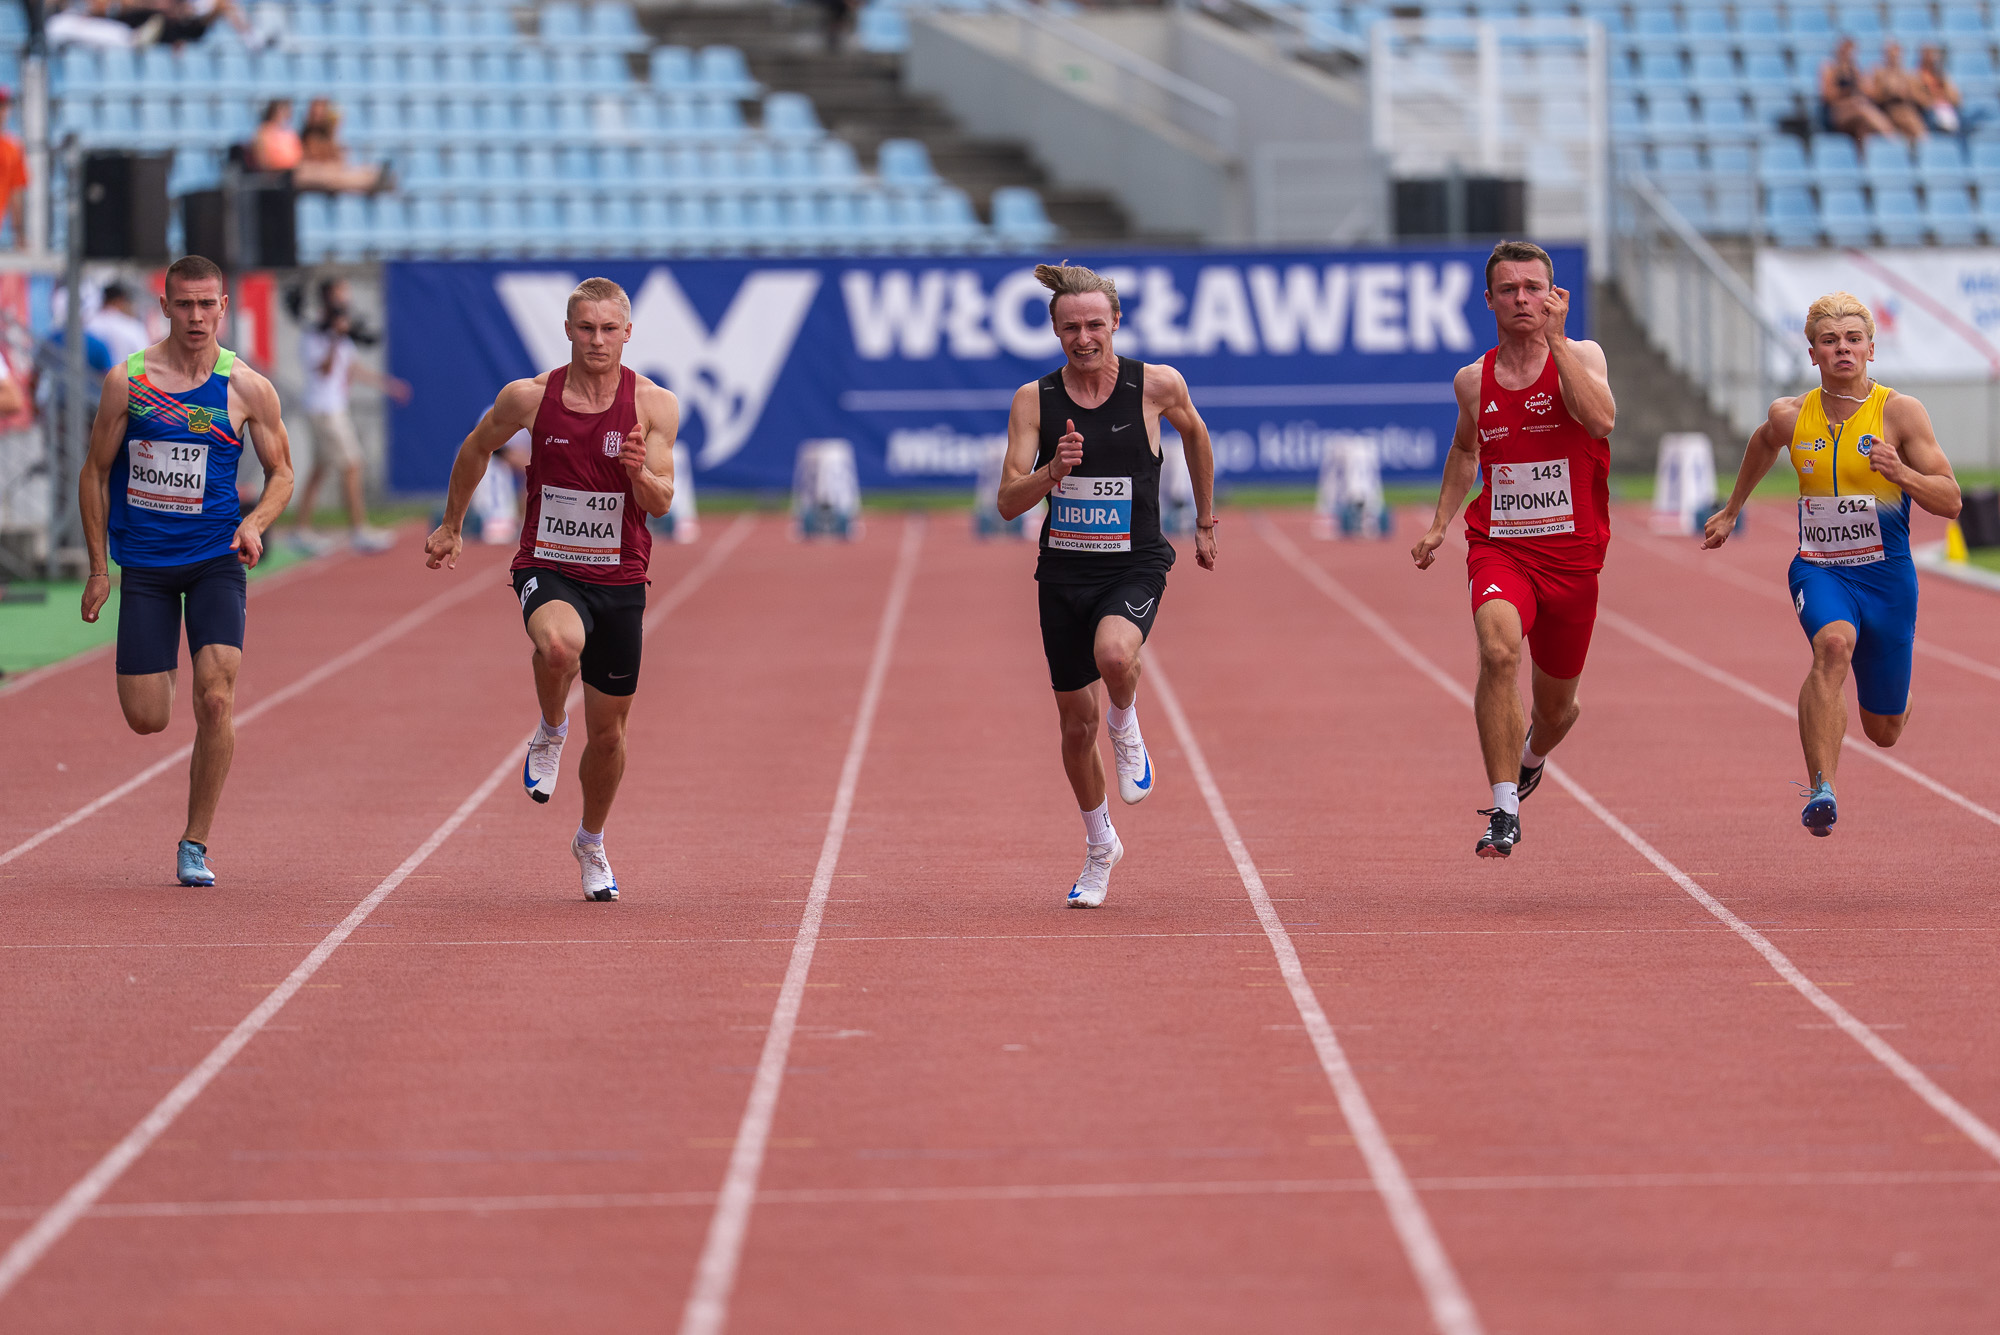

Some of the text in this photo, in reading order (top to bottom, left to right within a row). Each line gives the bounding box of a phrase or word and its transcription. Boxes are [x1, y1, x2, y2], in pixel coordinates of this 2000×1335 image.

[171, 447, 201, 462] 119
[132, 465, 201, 489] SŁOMSKI
[1531, 464, 1562, 481] 143
[1093, 482, 1124, 496] 552
[131, 498, 193, 512] WŁOCŁAWEK 2025
[586, 497, 617, 511] 410
[1494, 490, 1569, 511] LEPIONKA
[1837, 500, 1868, 515] 612
[1057, 506, 1121, 525] LIBURA
[545, 516, 615, 539] TABAKA
[1498, 524, 1565, 536] WŁOCŁAWEK 2025
[1804, 523, 1877, 543] WOJTASIK
[561, 545, 590, 553] Mistrzostwa
[1054, 540, 1102, 549] WŁOCŁAWEK
[543, 550, 592, 562] WŁOCŁAWEK
[1856, 555, 1876, 563] 2025
